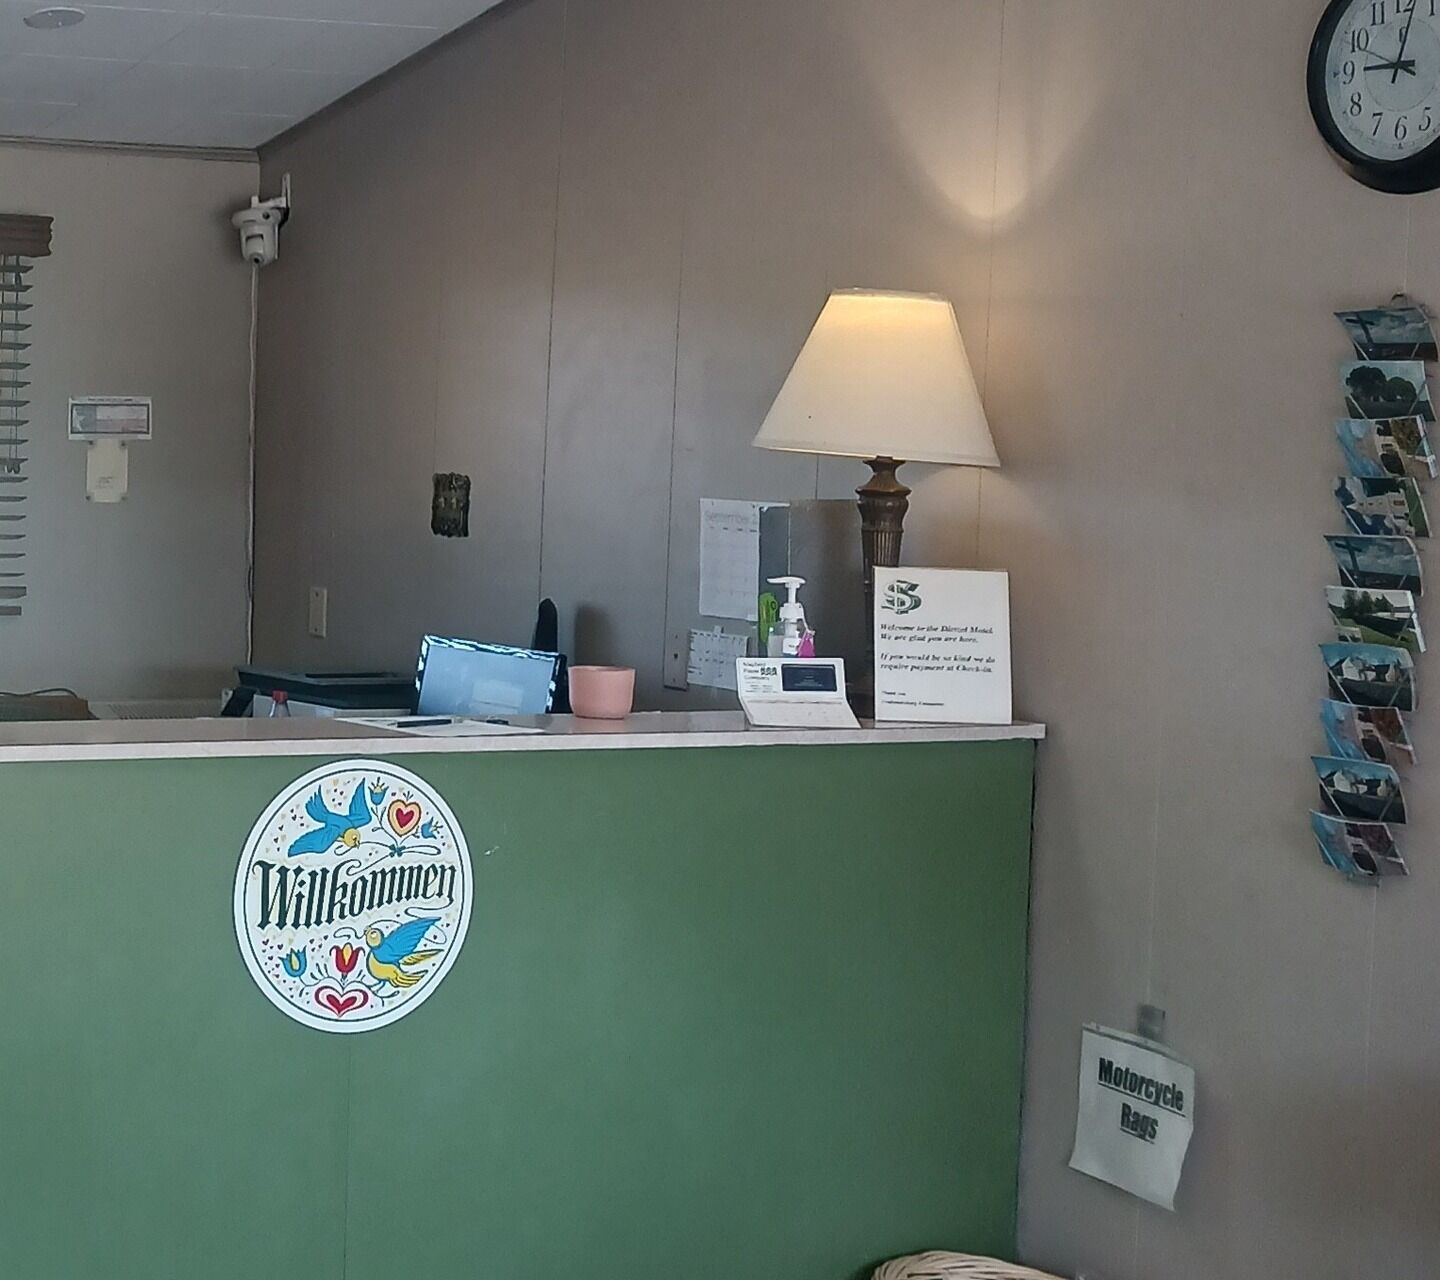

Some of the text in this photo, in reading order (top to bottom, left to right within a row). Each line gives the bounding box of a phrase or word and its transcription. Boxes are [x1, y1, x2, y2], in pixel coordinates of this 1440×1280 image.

[1371, 1, 1385, 26] 11
[1351, 28, 1369, 53] 10
[1343, 61, 1355, 85] 9
[1350, 92, 1361, 116] 8
[1372, 112, 1383, 136] 7
[1395, 116, 1407, 140] 6
[1419, 107, 1432, 131] 5
[253, 859, 456, 930] Willkommen
[1098, 1057, 1184, 1111] Motorcycle
[1121, 1102, 1159, 1140] Rags
